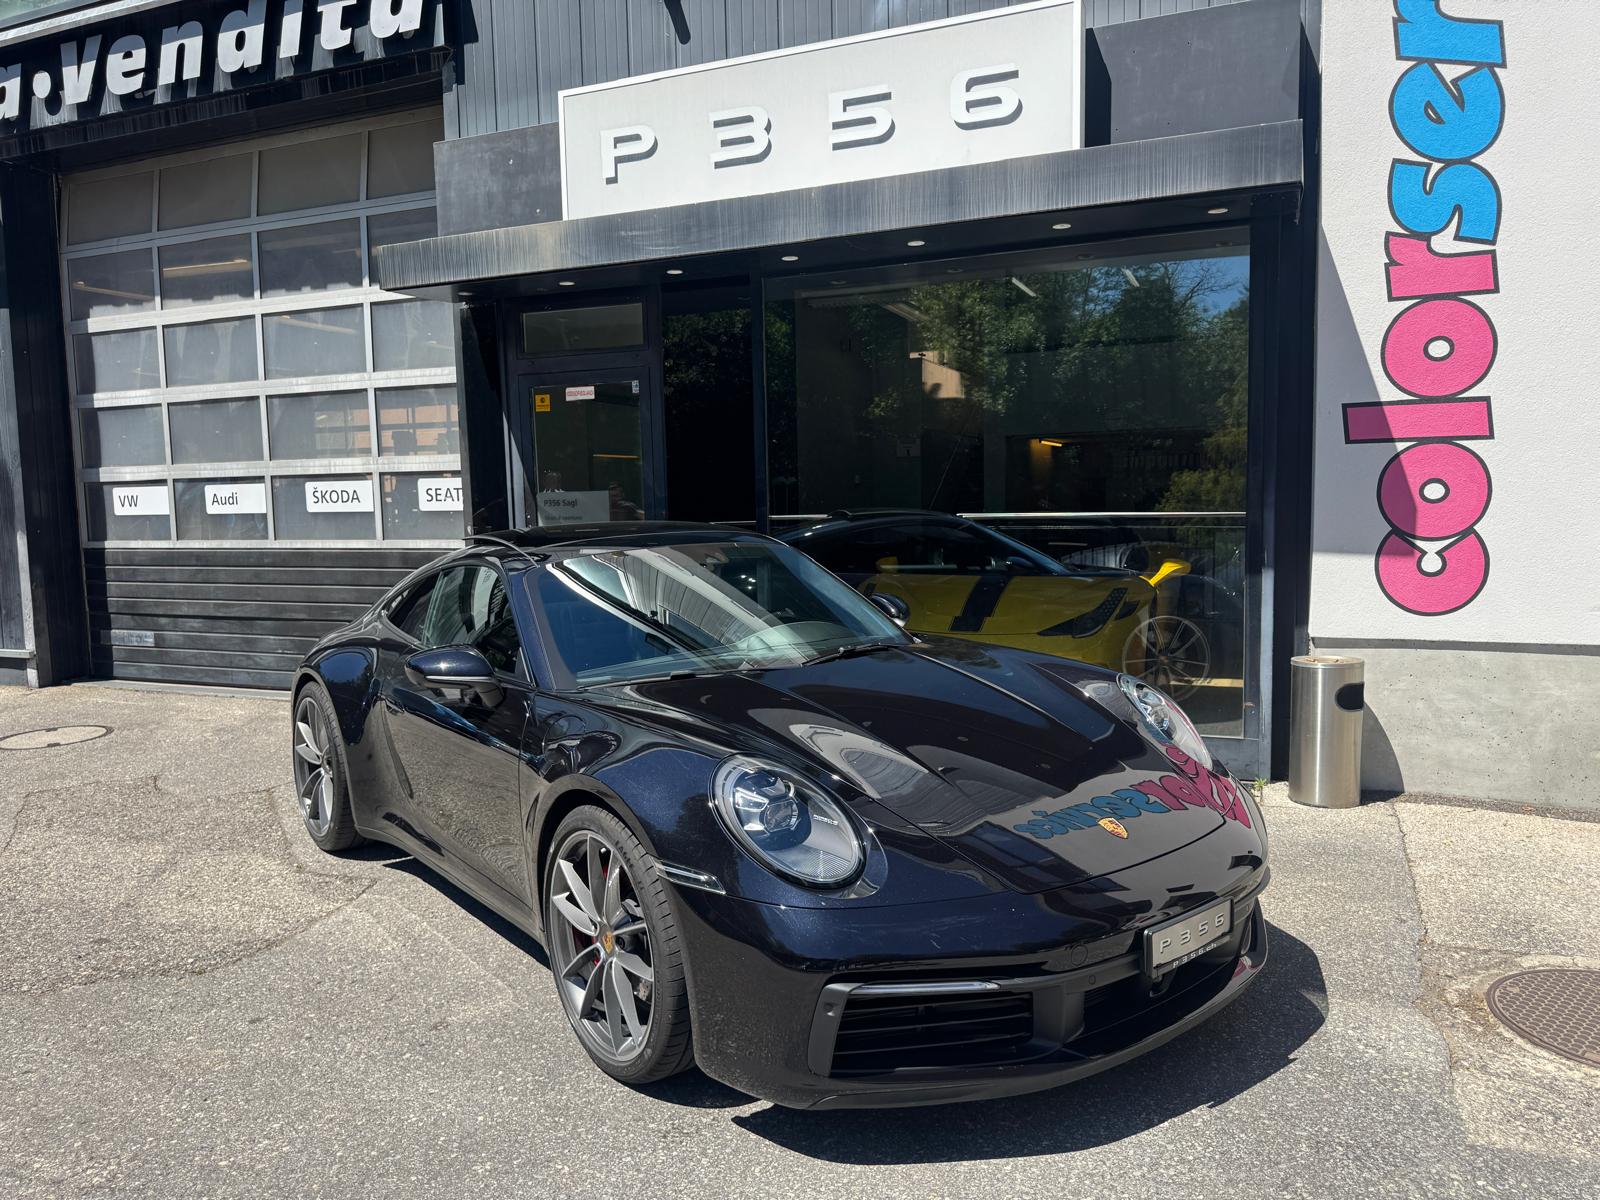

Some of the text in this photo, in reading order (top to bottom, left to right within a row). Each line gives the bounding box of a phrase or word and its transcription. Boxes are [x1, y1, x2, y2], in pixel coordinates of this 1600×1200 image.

[118, 494, 139, 508] VW
[211, 492, 239, 506] Audi
[312, 486, 361, 504] ŠKODA
[425, 487, 463, 502] SEAT
